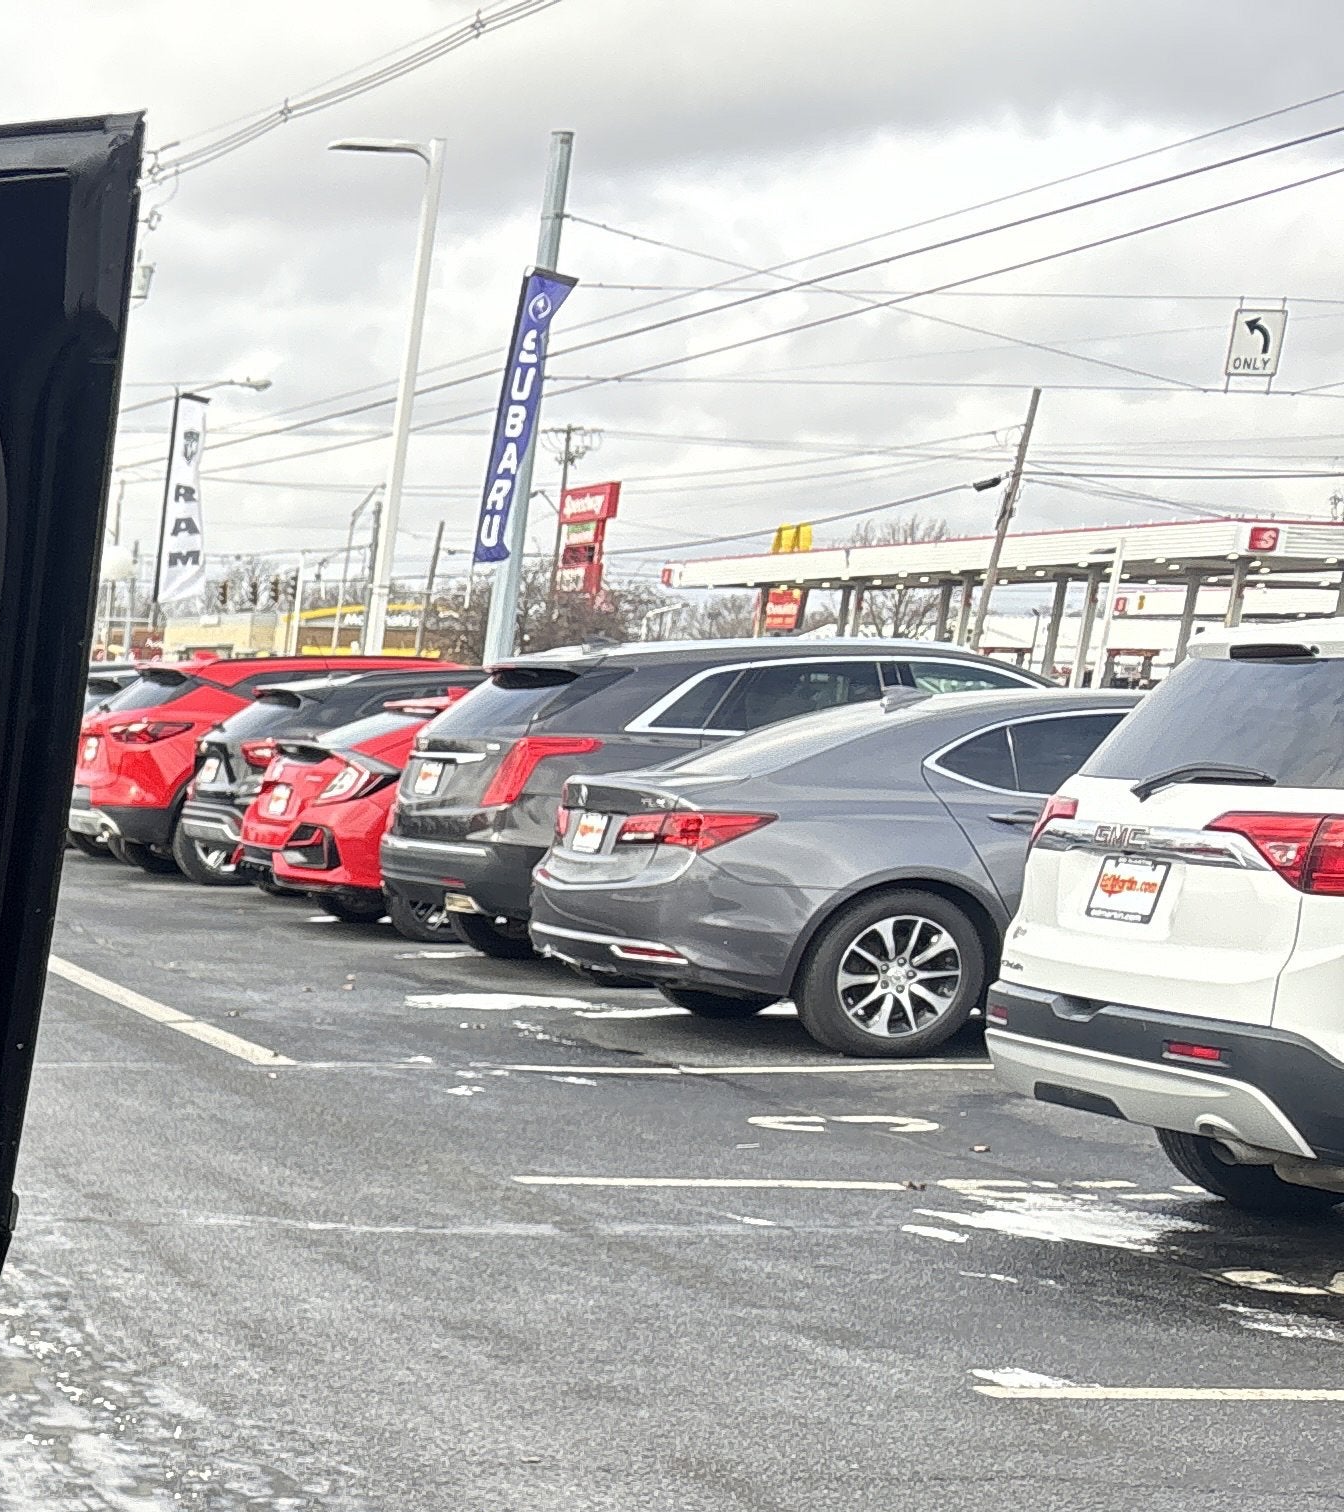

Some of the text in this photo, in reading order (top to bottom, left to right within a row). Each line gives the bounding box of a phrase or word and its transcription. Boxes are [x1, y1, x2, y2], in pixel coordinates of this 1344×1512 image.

[1232, 357, 1271, 371] ONLY
[480, 328, 538, 548] SUBARU
[168, 483, 200, 568] RAM
[1094, 824, 1150, 849] GMC
